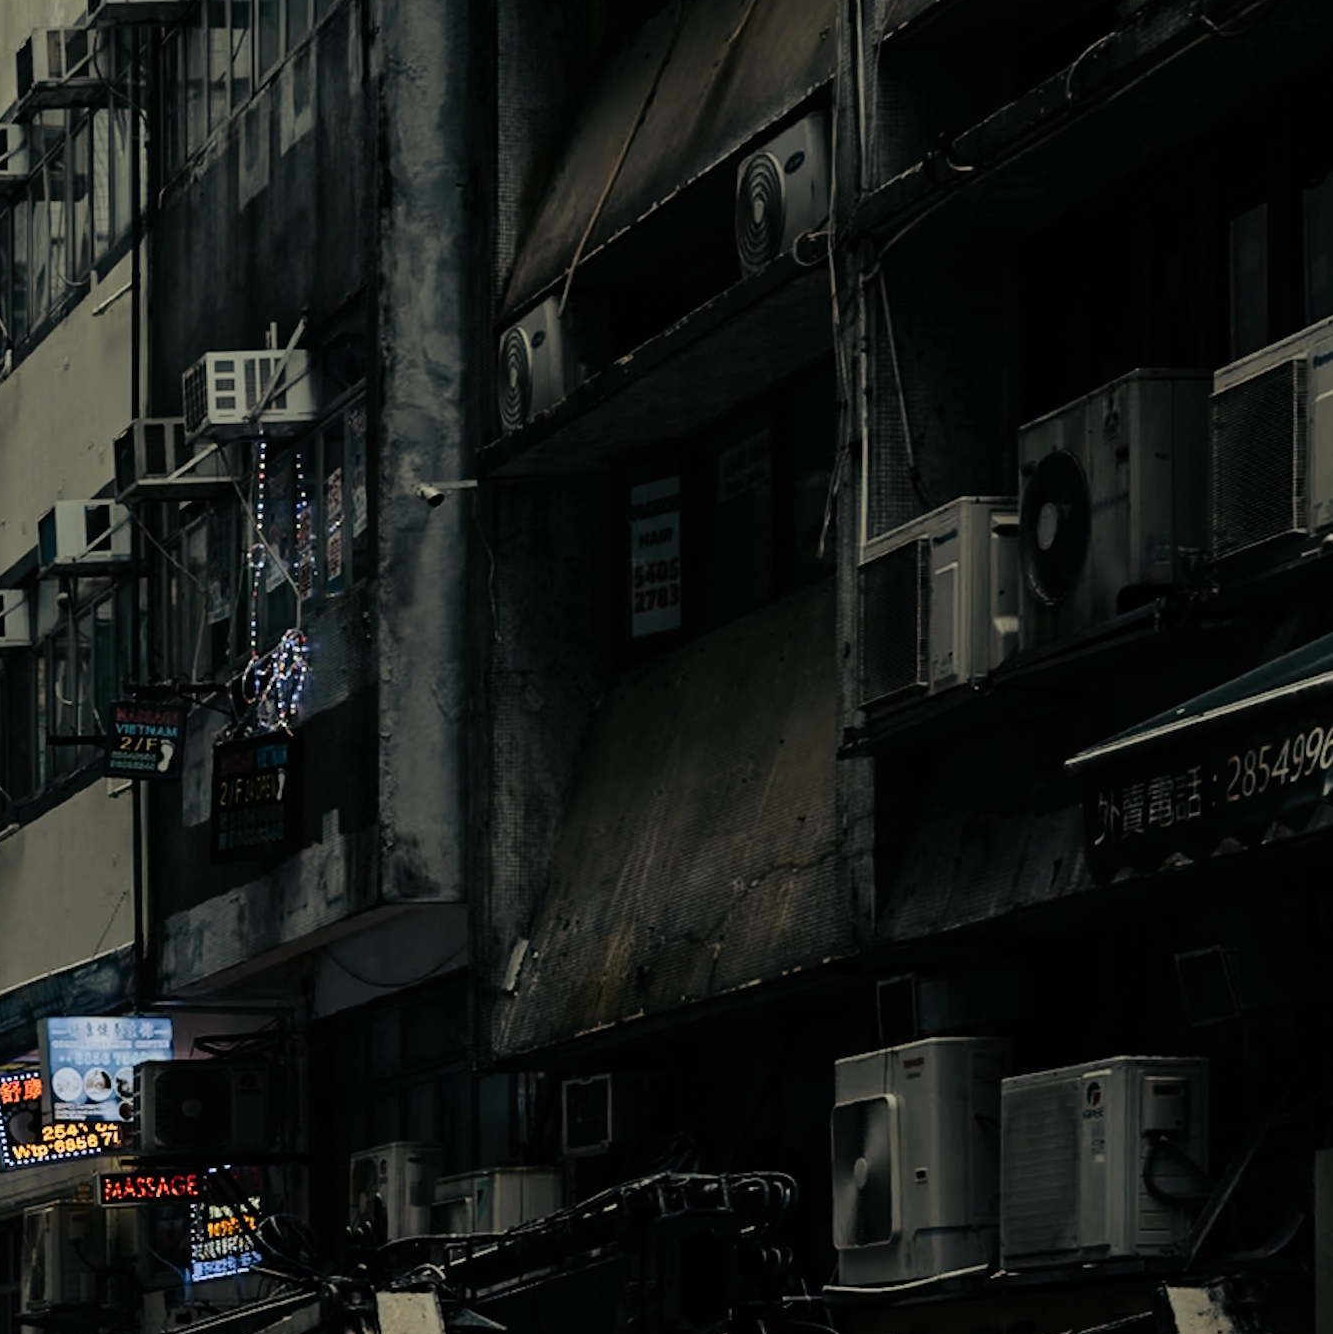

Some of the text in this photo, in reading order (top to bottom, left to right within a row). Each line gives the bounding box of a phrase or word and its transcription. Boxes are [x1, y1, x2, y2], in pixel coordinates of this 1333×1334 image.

[115, 723, 178, 738] VIETNAM
[119, 736, 158, 751] 2/F
[103, 1173, 199, 1201] MASSAGE
